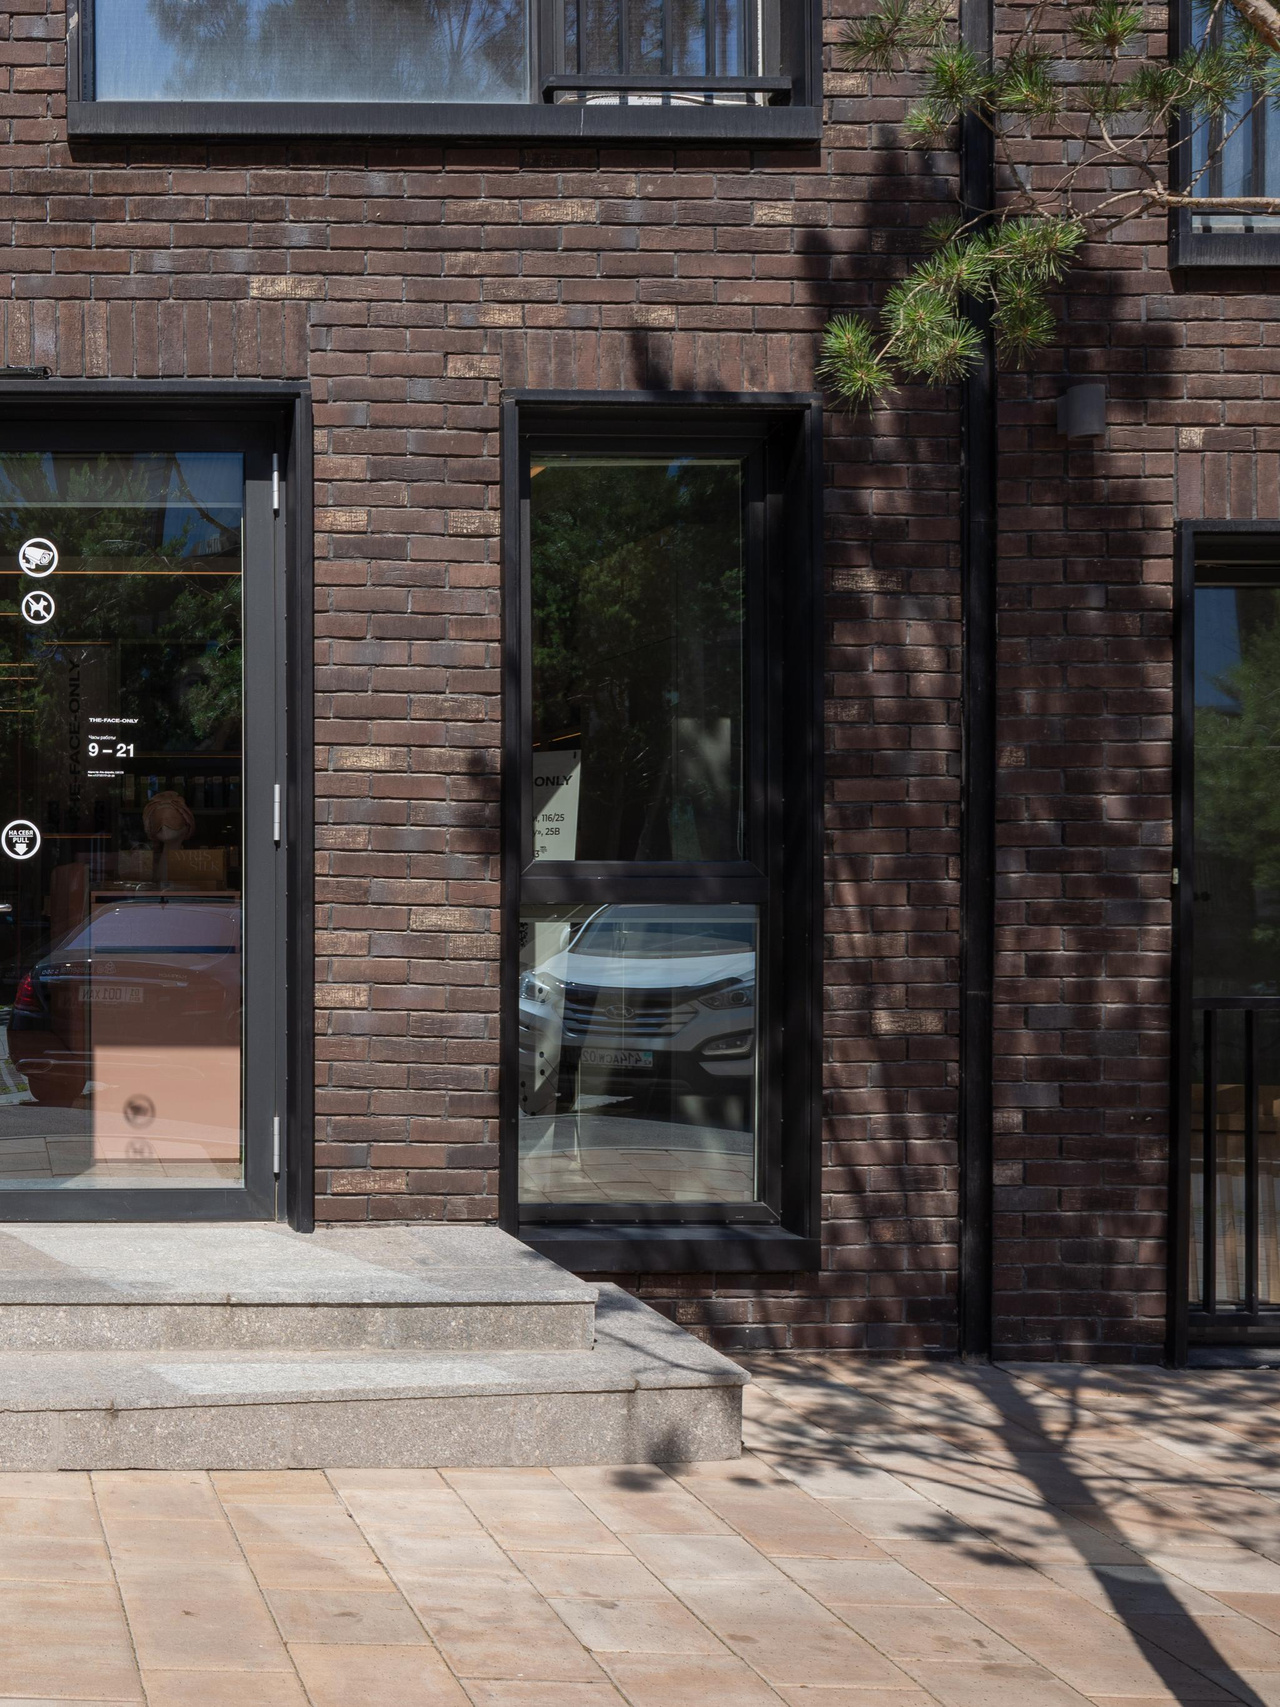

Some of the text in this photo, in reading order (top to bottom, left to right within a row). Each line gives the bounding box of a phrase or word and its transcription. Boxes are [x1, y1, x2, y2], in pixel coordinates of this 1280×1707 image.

[88, 742, 99, 757] 9
[116, 743, 134, 757] 21
[542, 814, 565, 823] 116/25
